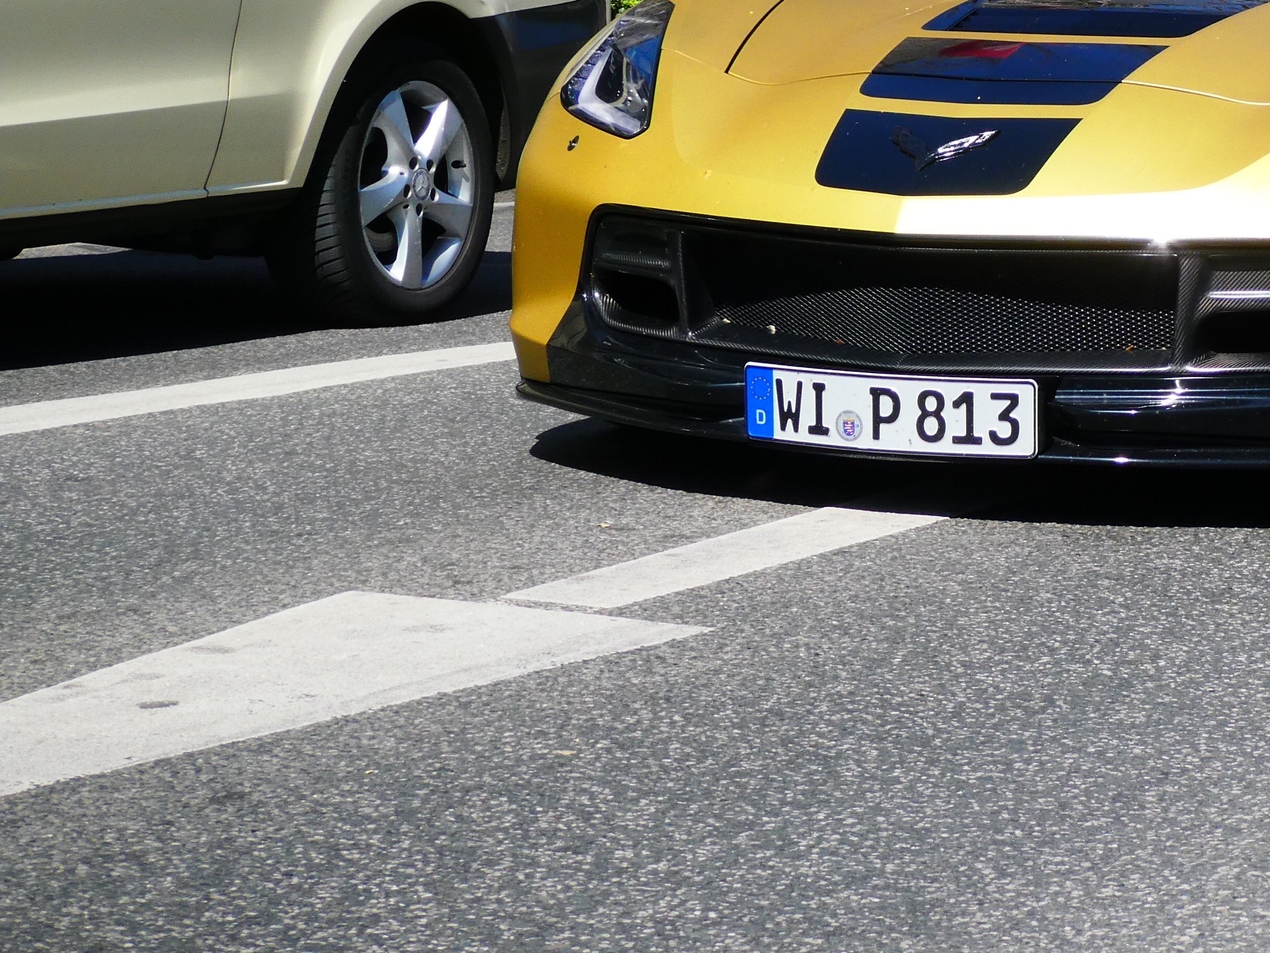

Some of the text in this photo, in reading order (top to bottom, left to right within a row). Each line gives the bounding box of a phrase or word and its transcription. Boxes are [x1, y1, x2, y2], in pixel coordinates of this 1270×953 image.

[756, 409, 767, 425] D
[775, 378, 830, 436] WI
[869, 386, 901, 441] P
[915, 389, 1020, 446] 813
